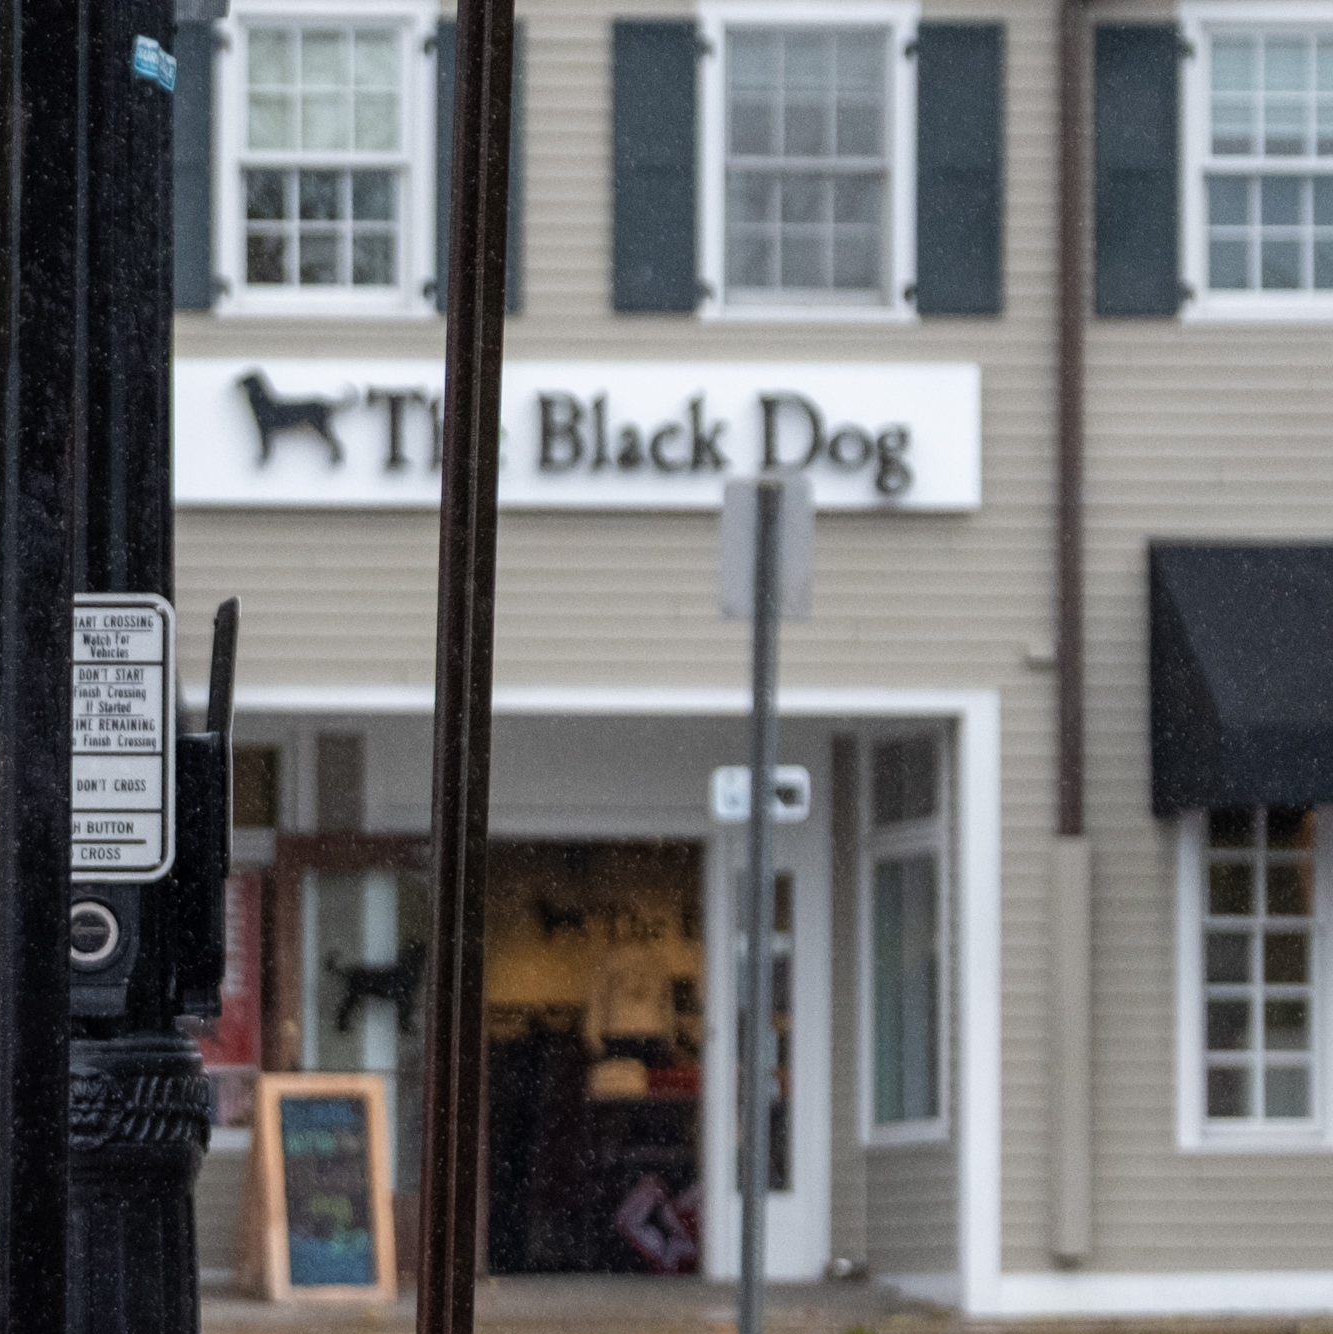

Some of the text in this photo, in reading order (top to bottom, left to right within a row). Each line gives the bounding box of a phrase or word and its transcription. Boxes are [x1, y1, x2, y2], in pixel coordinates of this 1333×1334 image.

[535, 388, 731, 475] Black
[757, 390, 913, 497] Dog
[74, 615, 154, 628] TART CROSSING
[82, 632, 130, 645] Watch For
[90, 646, 130, 659] Vehicles
[79, 668, 145, 682] DON'T START
[74, 685, 147, 702] Finish Crossing
[98, 701, 132, 714] Started
[98, 719, 156, 732] REMAINING
[83, 735, 111, 747] Finish
[118, 735, 157, 750] Crossing
[77, 779, 147, 792] DON'T CROSS
[87, 821, 133, 834] BUTTON
[80, 847, 121, 860] CROSS
